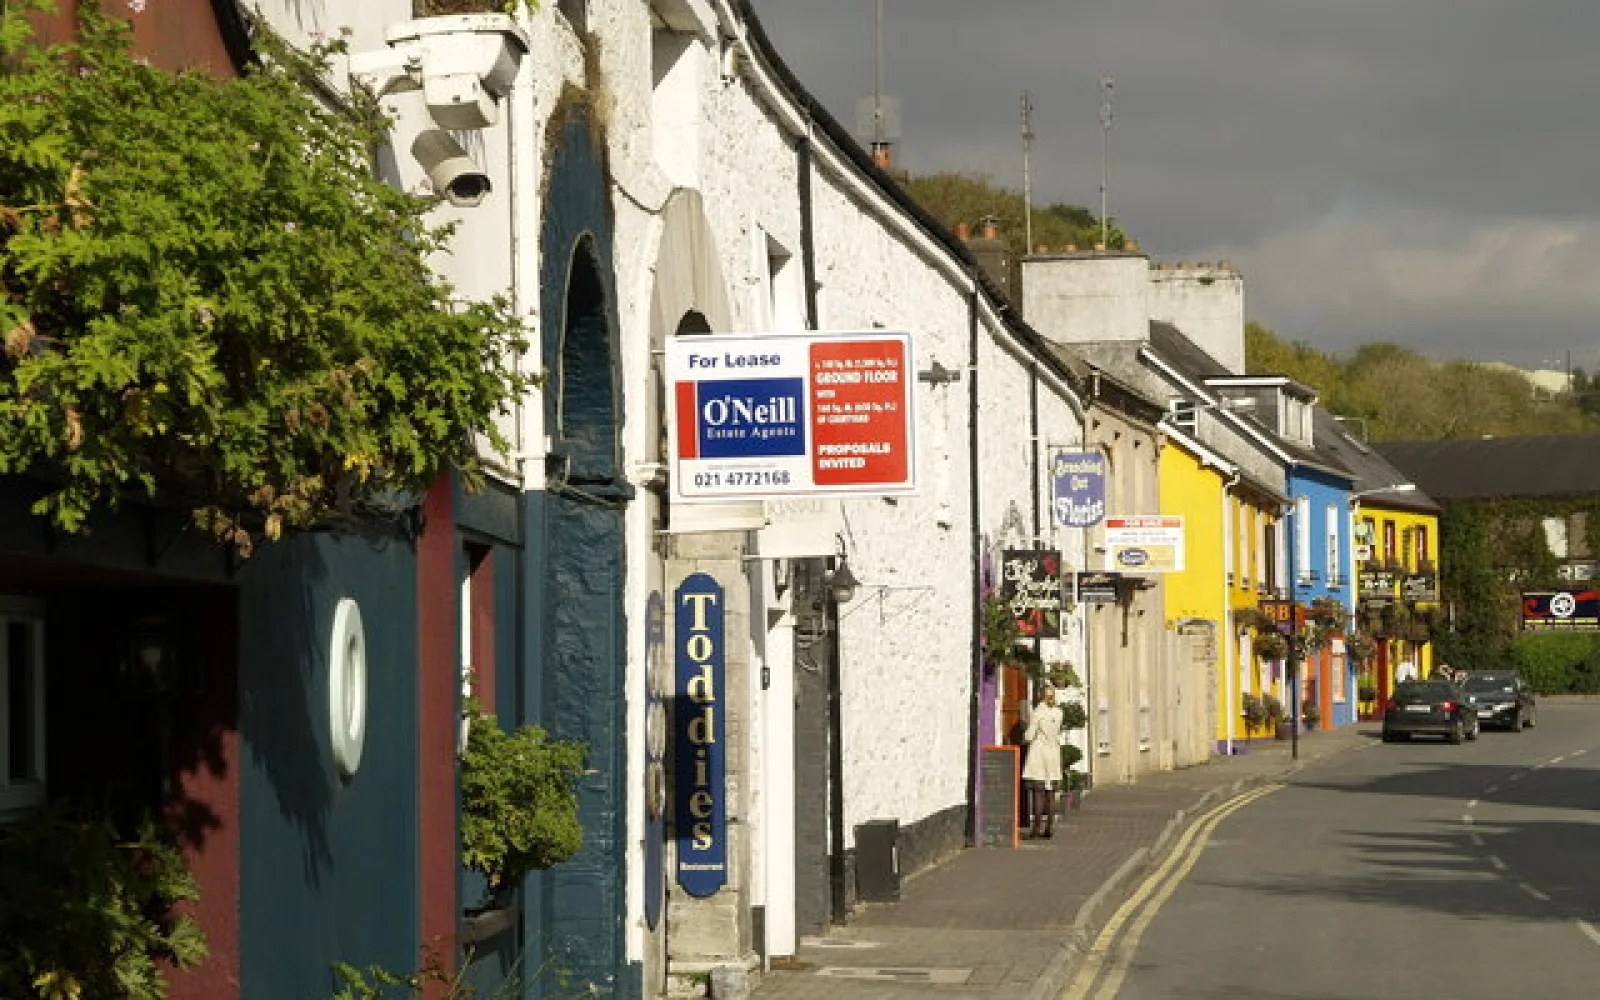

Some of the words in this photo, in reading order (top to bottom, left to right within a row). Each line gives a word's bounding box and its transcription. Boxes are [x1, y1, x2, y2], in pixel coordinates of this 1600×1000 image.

[689, 354, 718, 368] For
[724, 352, 781, 367] Lease
[816, 372, 862, 385] GROUND
[864, 370, 898, 383] FLOOR
[704, 394, 796, 425] O'Neill
[706, 428, 746, 439] Estate
[751, 426, 796, 440] Agents
[819, 443, 891, 456] PROPOSALS
[819, 457, 866, 469] INVITED
[694, 472, 720, 486] 021
[724, 470, 791, 485] 4772168
[682, 594, 717, 851] Toddies
